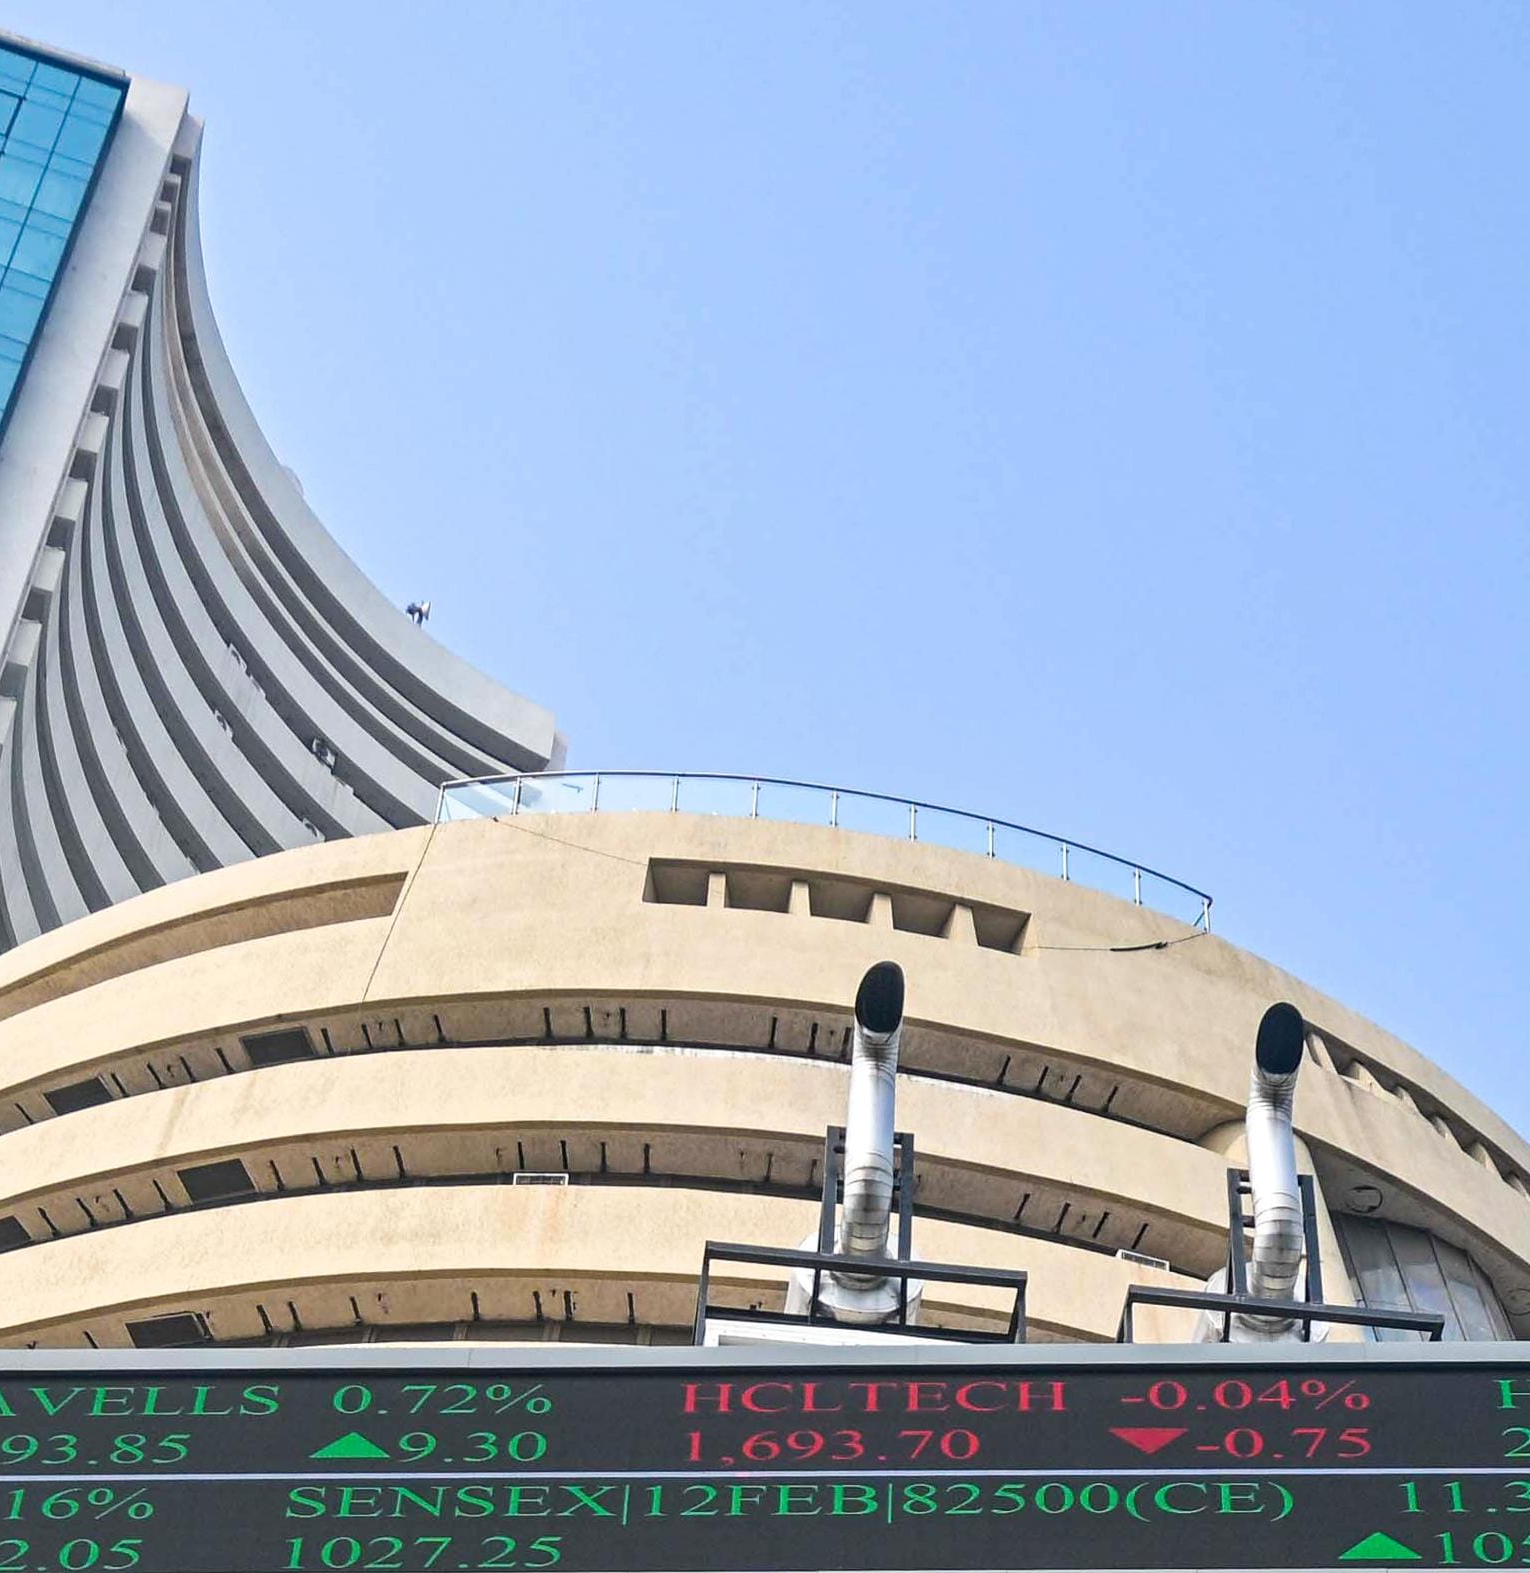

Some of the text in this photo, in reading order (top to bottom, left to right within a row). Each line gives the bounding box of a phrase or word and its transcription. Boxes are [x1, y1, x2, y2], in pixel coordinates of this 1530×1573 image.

[331, 1384, 553, 1415] 0.72%
[1121, 1380, 1371, 1411] -0.04%
[397, 1432, 548, 1463] 9.30
[684, 1429, 981, 1466] 1,693.70
[1194, 1427, 1371, 1459] -0.75
[283, 1536, 564, 1570] 1027.25
